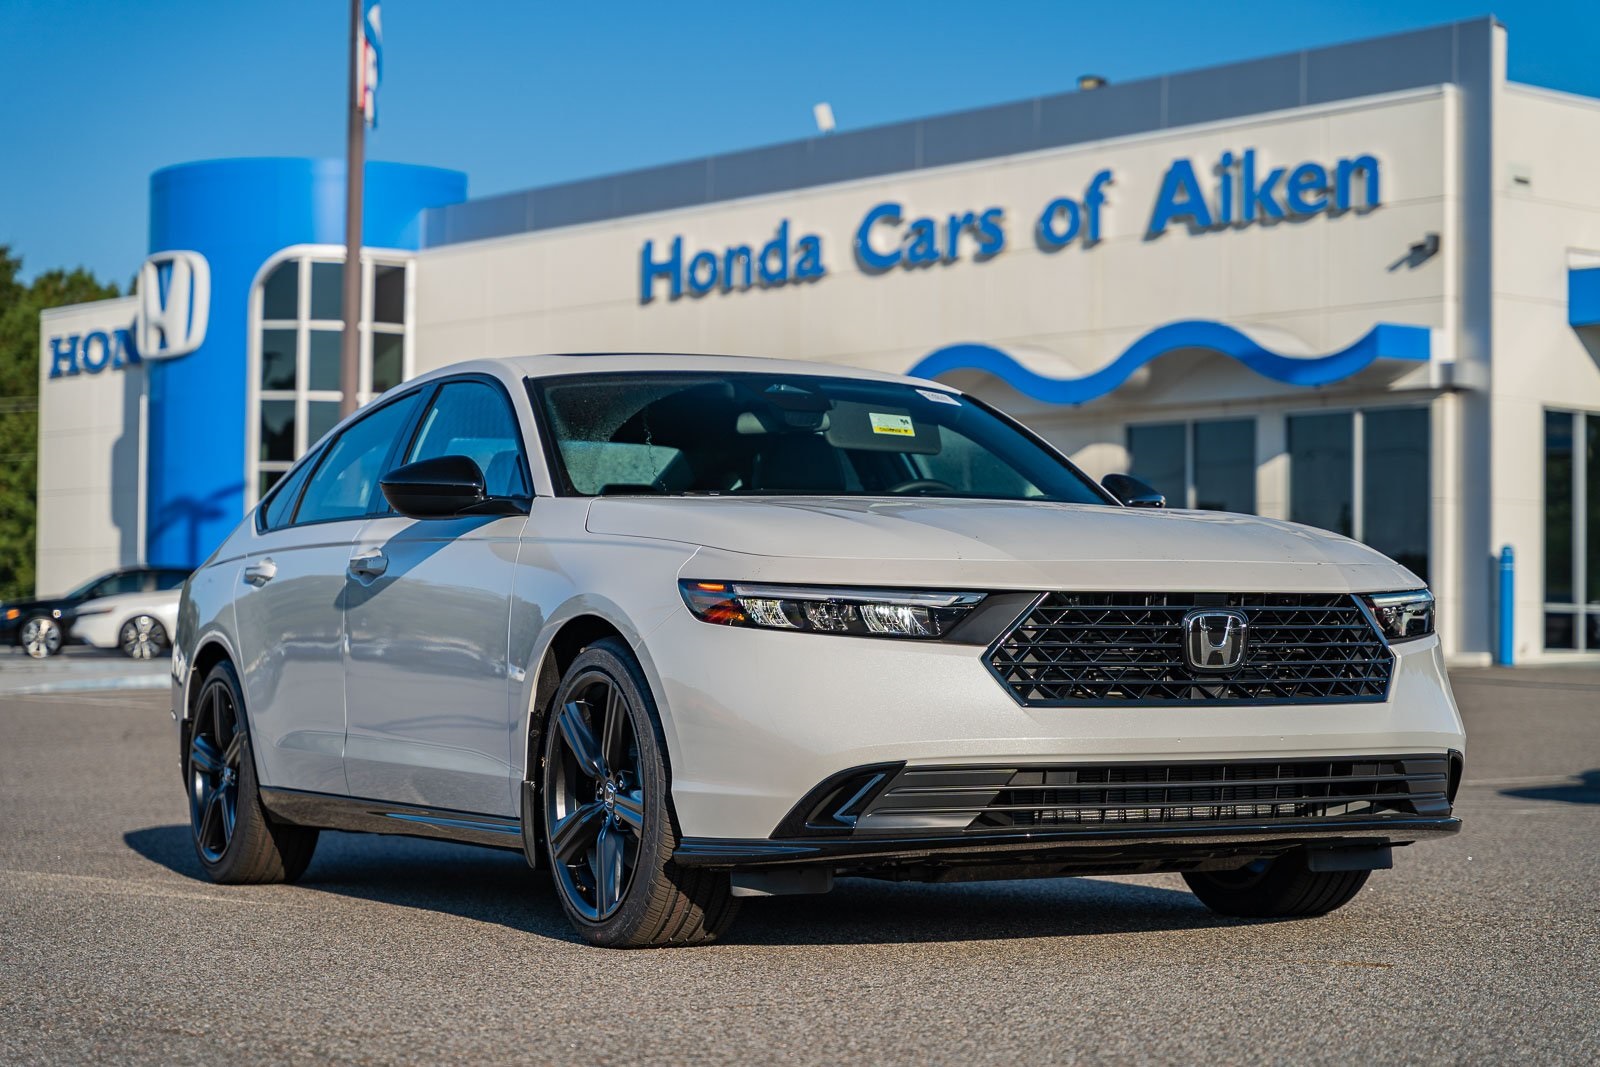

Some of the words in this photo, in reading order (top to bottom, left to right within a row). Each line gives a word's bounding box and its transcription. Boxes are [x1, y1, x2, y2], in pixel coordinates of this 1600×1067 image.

[639, 218, 825, 302] Honda
[856, 202, 1004, 272] Cars
[1038, 168, 1113, 247] of
[1149, 148, 1379, 234] Aiken
